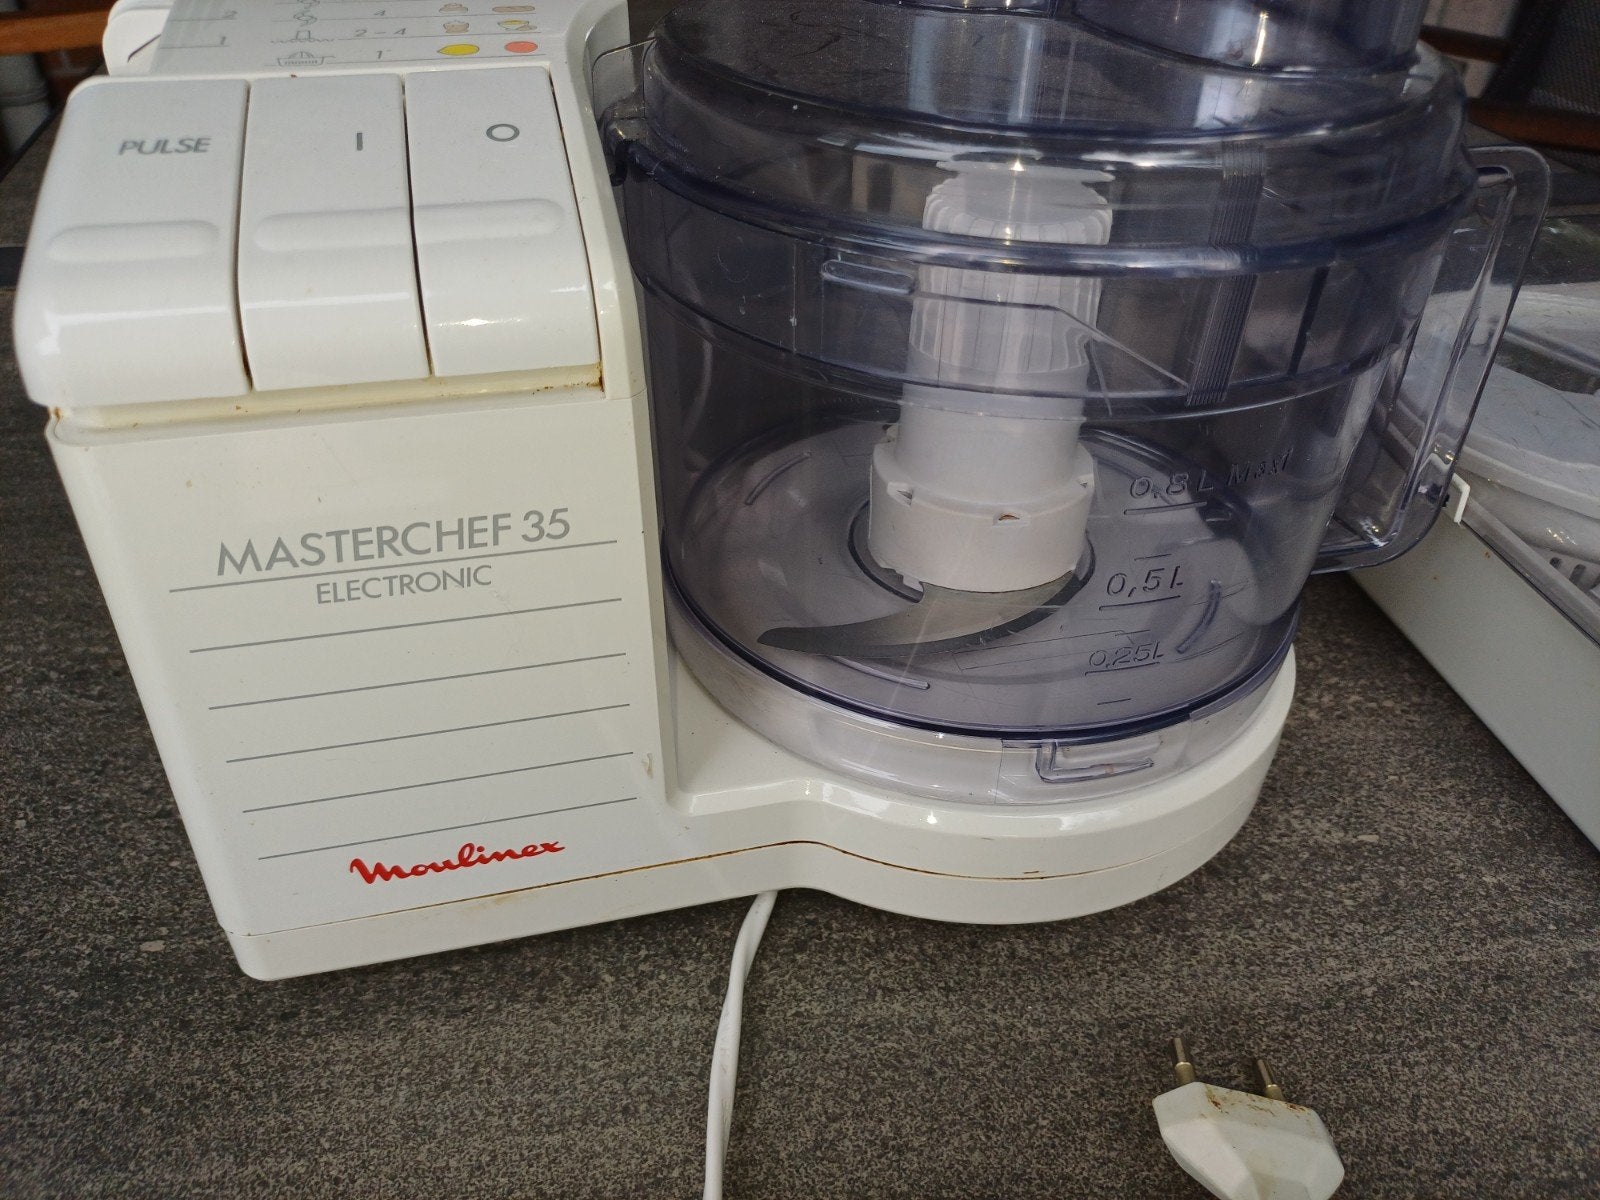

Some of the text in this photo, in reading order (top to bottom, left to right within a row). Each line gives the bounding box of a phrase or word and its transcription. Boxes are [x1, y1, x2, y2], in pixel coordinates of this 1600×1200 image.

[354, 28, 368, 38] 2
[393, 27, 407, 36] 4
[119, 137, 211, 155] PULSE
[217, 507, 571, 576] MASTERCHEF 35
[316, 565, 493, 604] ELECTRONIC
[349, 841, 565, 884] Moulinex
